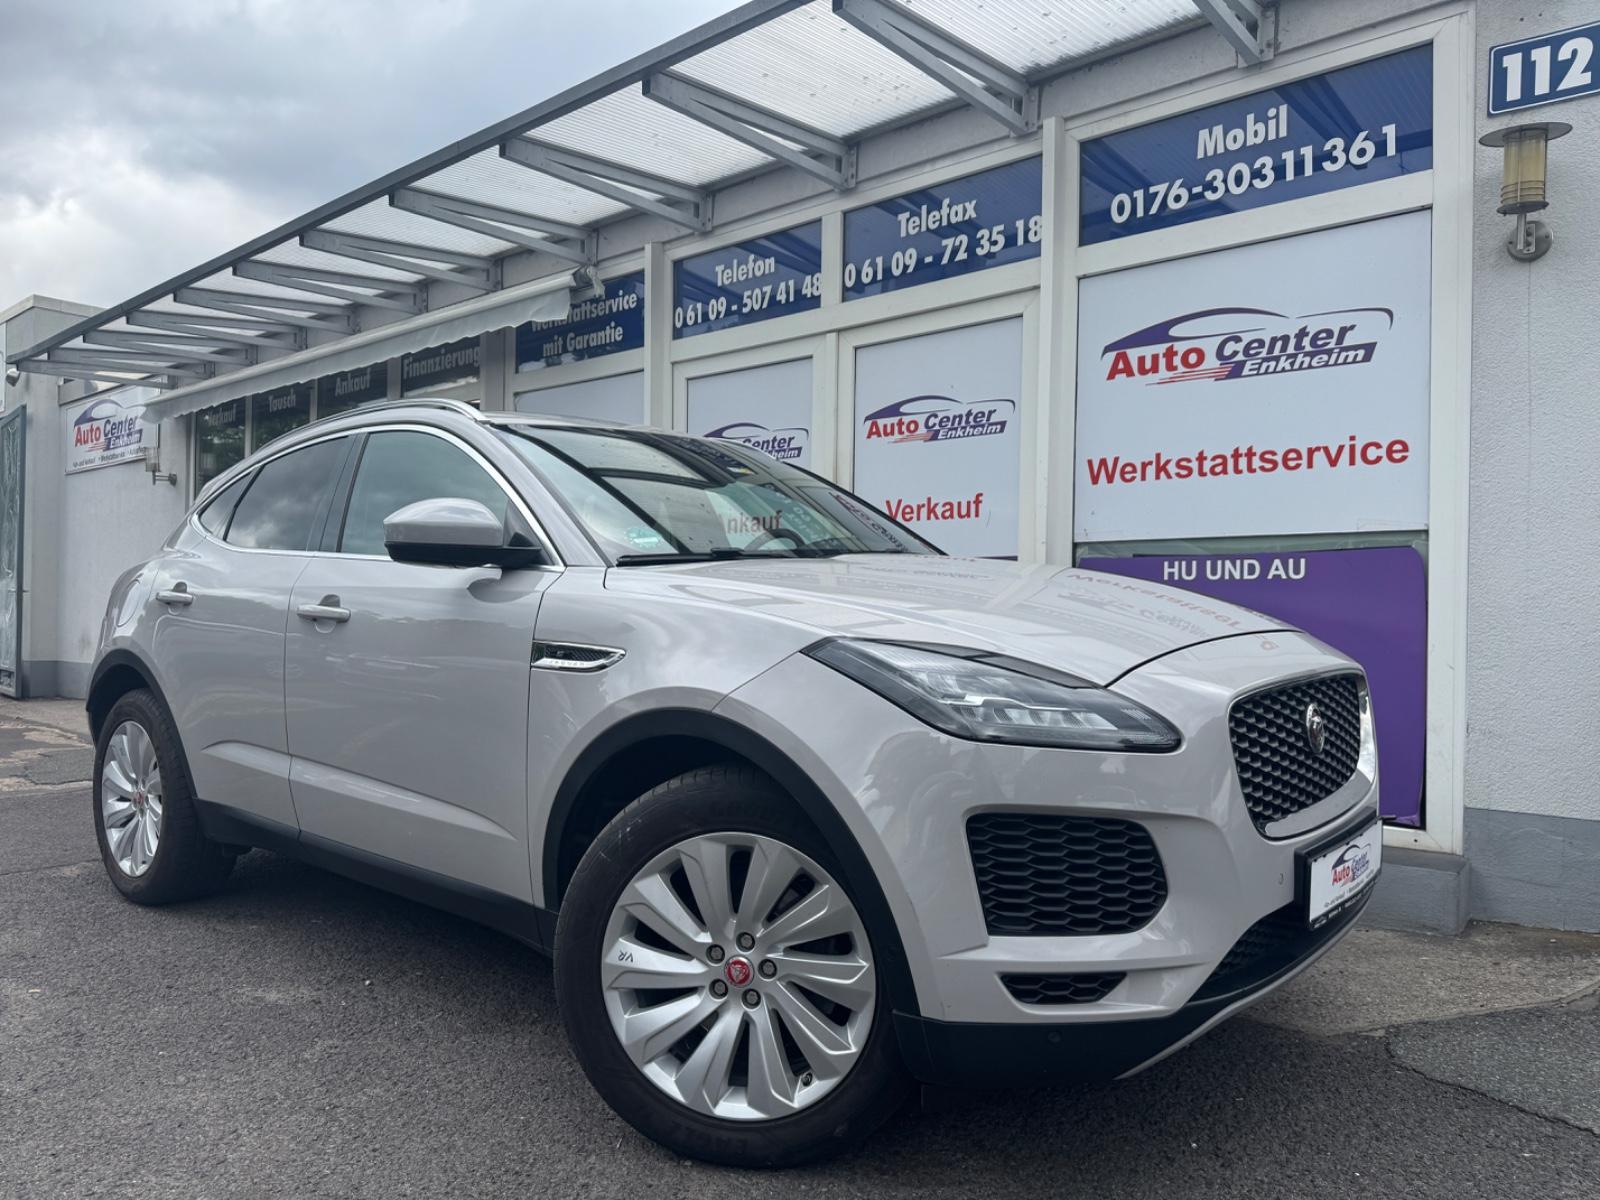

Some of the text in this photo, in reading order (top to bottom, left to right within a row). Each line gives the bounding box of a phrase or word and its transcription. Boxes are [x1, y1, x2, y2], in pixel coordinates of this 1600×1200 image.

[1502, 36, 1594, 102] 112
[1196, 103, 1288, 160] Mobil
[897, 197, 977, 238] Telefax
[891, 247, 917, 277] 09
[940, 233, 969, 266] 72
[975, 223, 1006, 257] 35
[1015, 214, 1042, 247] 18
[715, 253, 775, 287] Telefon
[708, 296, 727, 321] 09
[742, 284, 773, 314] 507
[776, 279, 795, 304] 41
[801, 272, 822, 299] 48
[542, 320, 624, 357] mit Garantie
[1105, 323, 1358, 381] Auto Center
[402, 348, 480, 380] Finanzierung
[1241, 346, 1366, 377] Enkheim
[334, 367, 371, 397] Ankauf
[268, 387, 297, 414] Tausch
[74, 414, 139, 448] Auto Center
[866, 408, 997, 439] Auto Center
[937, 423, 1001, 439] Enkheim
[1087, 434, 1410, 486] Werkstattservice
[885, 492, 984, 523] Verkauf
[1163, 557, 1306, 581] HU UND AU
